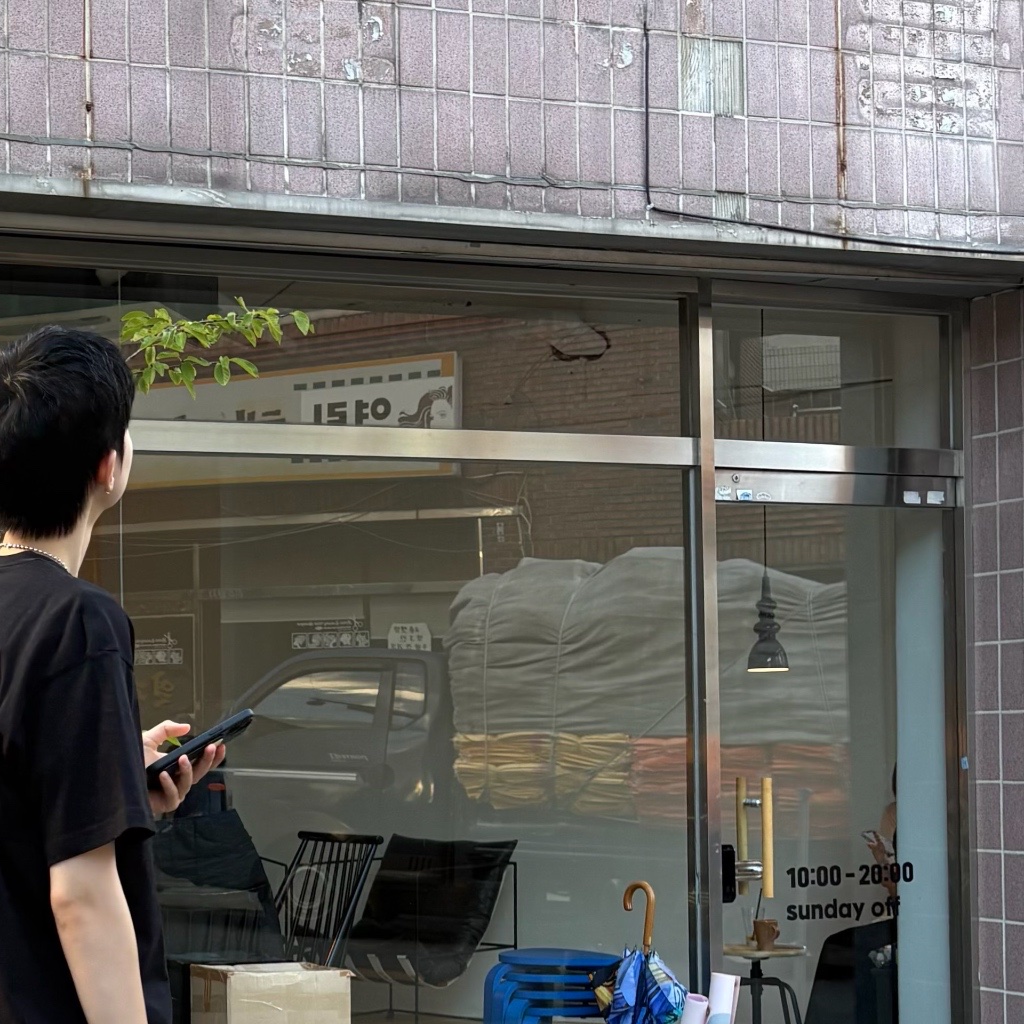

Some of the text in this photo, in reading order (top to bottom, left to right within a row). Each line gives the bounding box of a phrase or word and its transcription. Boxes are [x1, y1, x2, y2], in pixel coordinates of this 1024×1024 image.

[786, 865, 842, 888] 10:00
[858, 861, 914, 885] 20:00
[786, 896, 901, 921] sunday off
